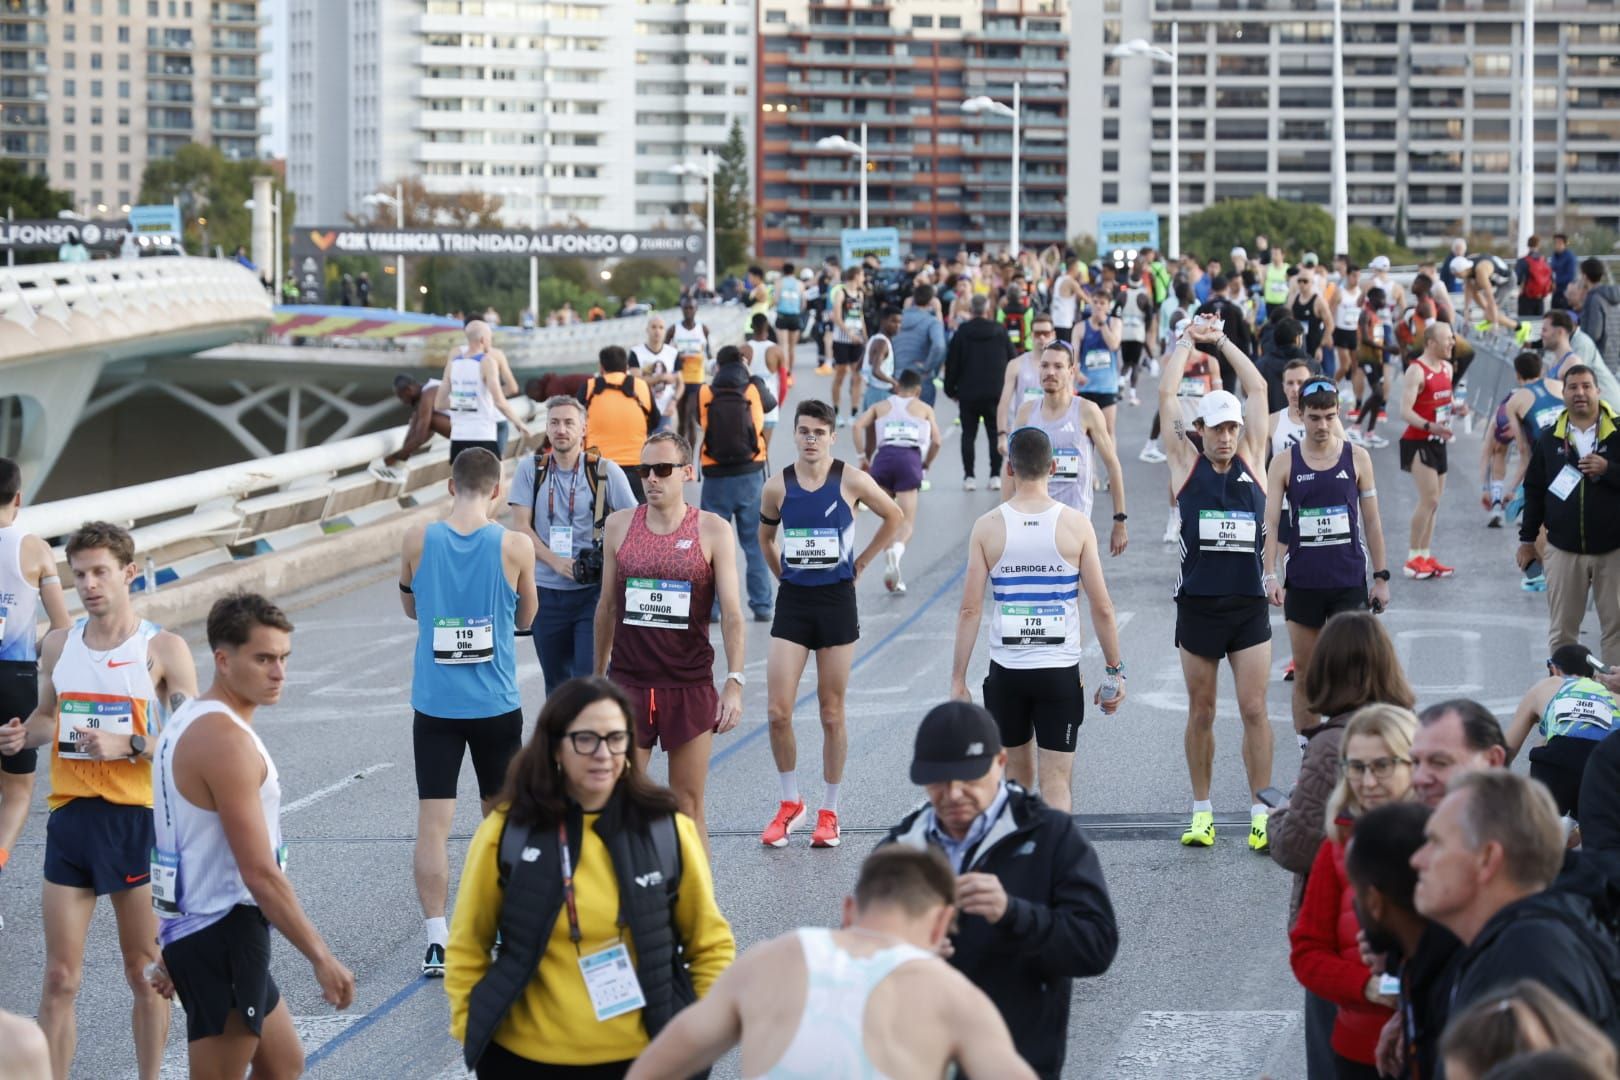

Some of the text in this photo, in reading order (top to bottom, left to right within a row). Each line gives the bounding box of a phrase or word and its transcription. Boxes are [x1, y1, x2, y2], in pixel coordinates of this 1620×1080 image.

[369, 233, 440, 251] VALENCIA
[442, 234, 528, 252] TRINIDAD
[529, 234, 618, 252] ALFONSO
[641, 237, 683, 249] ZURICH
[1220, 521, 1236, 530] 173
[1317, 517, 1331, 526] 141
[1218, 531, 1237, 540] Chris
[805, 539, 816, 548] 35
[796, 549, 826, 557] HAWKINS
[1001, 565, 1065, 573] CELBRIDGE A.C.
[650, 592, 663, 603] 69
[640, 603, 672, 614] CONNOR
[1025, 618, 1042, 626] 178
[456, 630, 473, 639] 119
[1020, 628, 1046, 636] HOARE
[457, 641, 473, 649] Olle
[86, 718, 100, 729] 30
